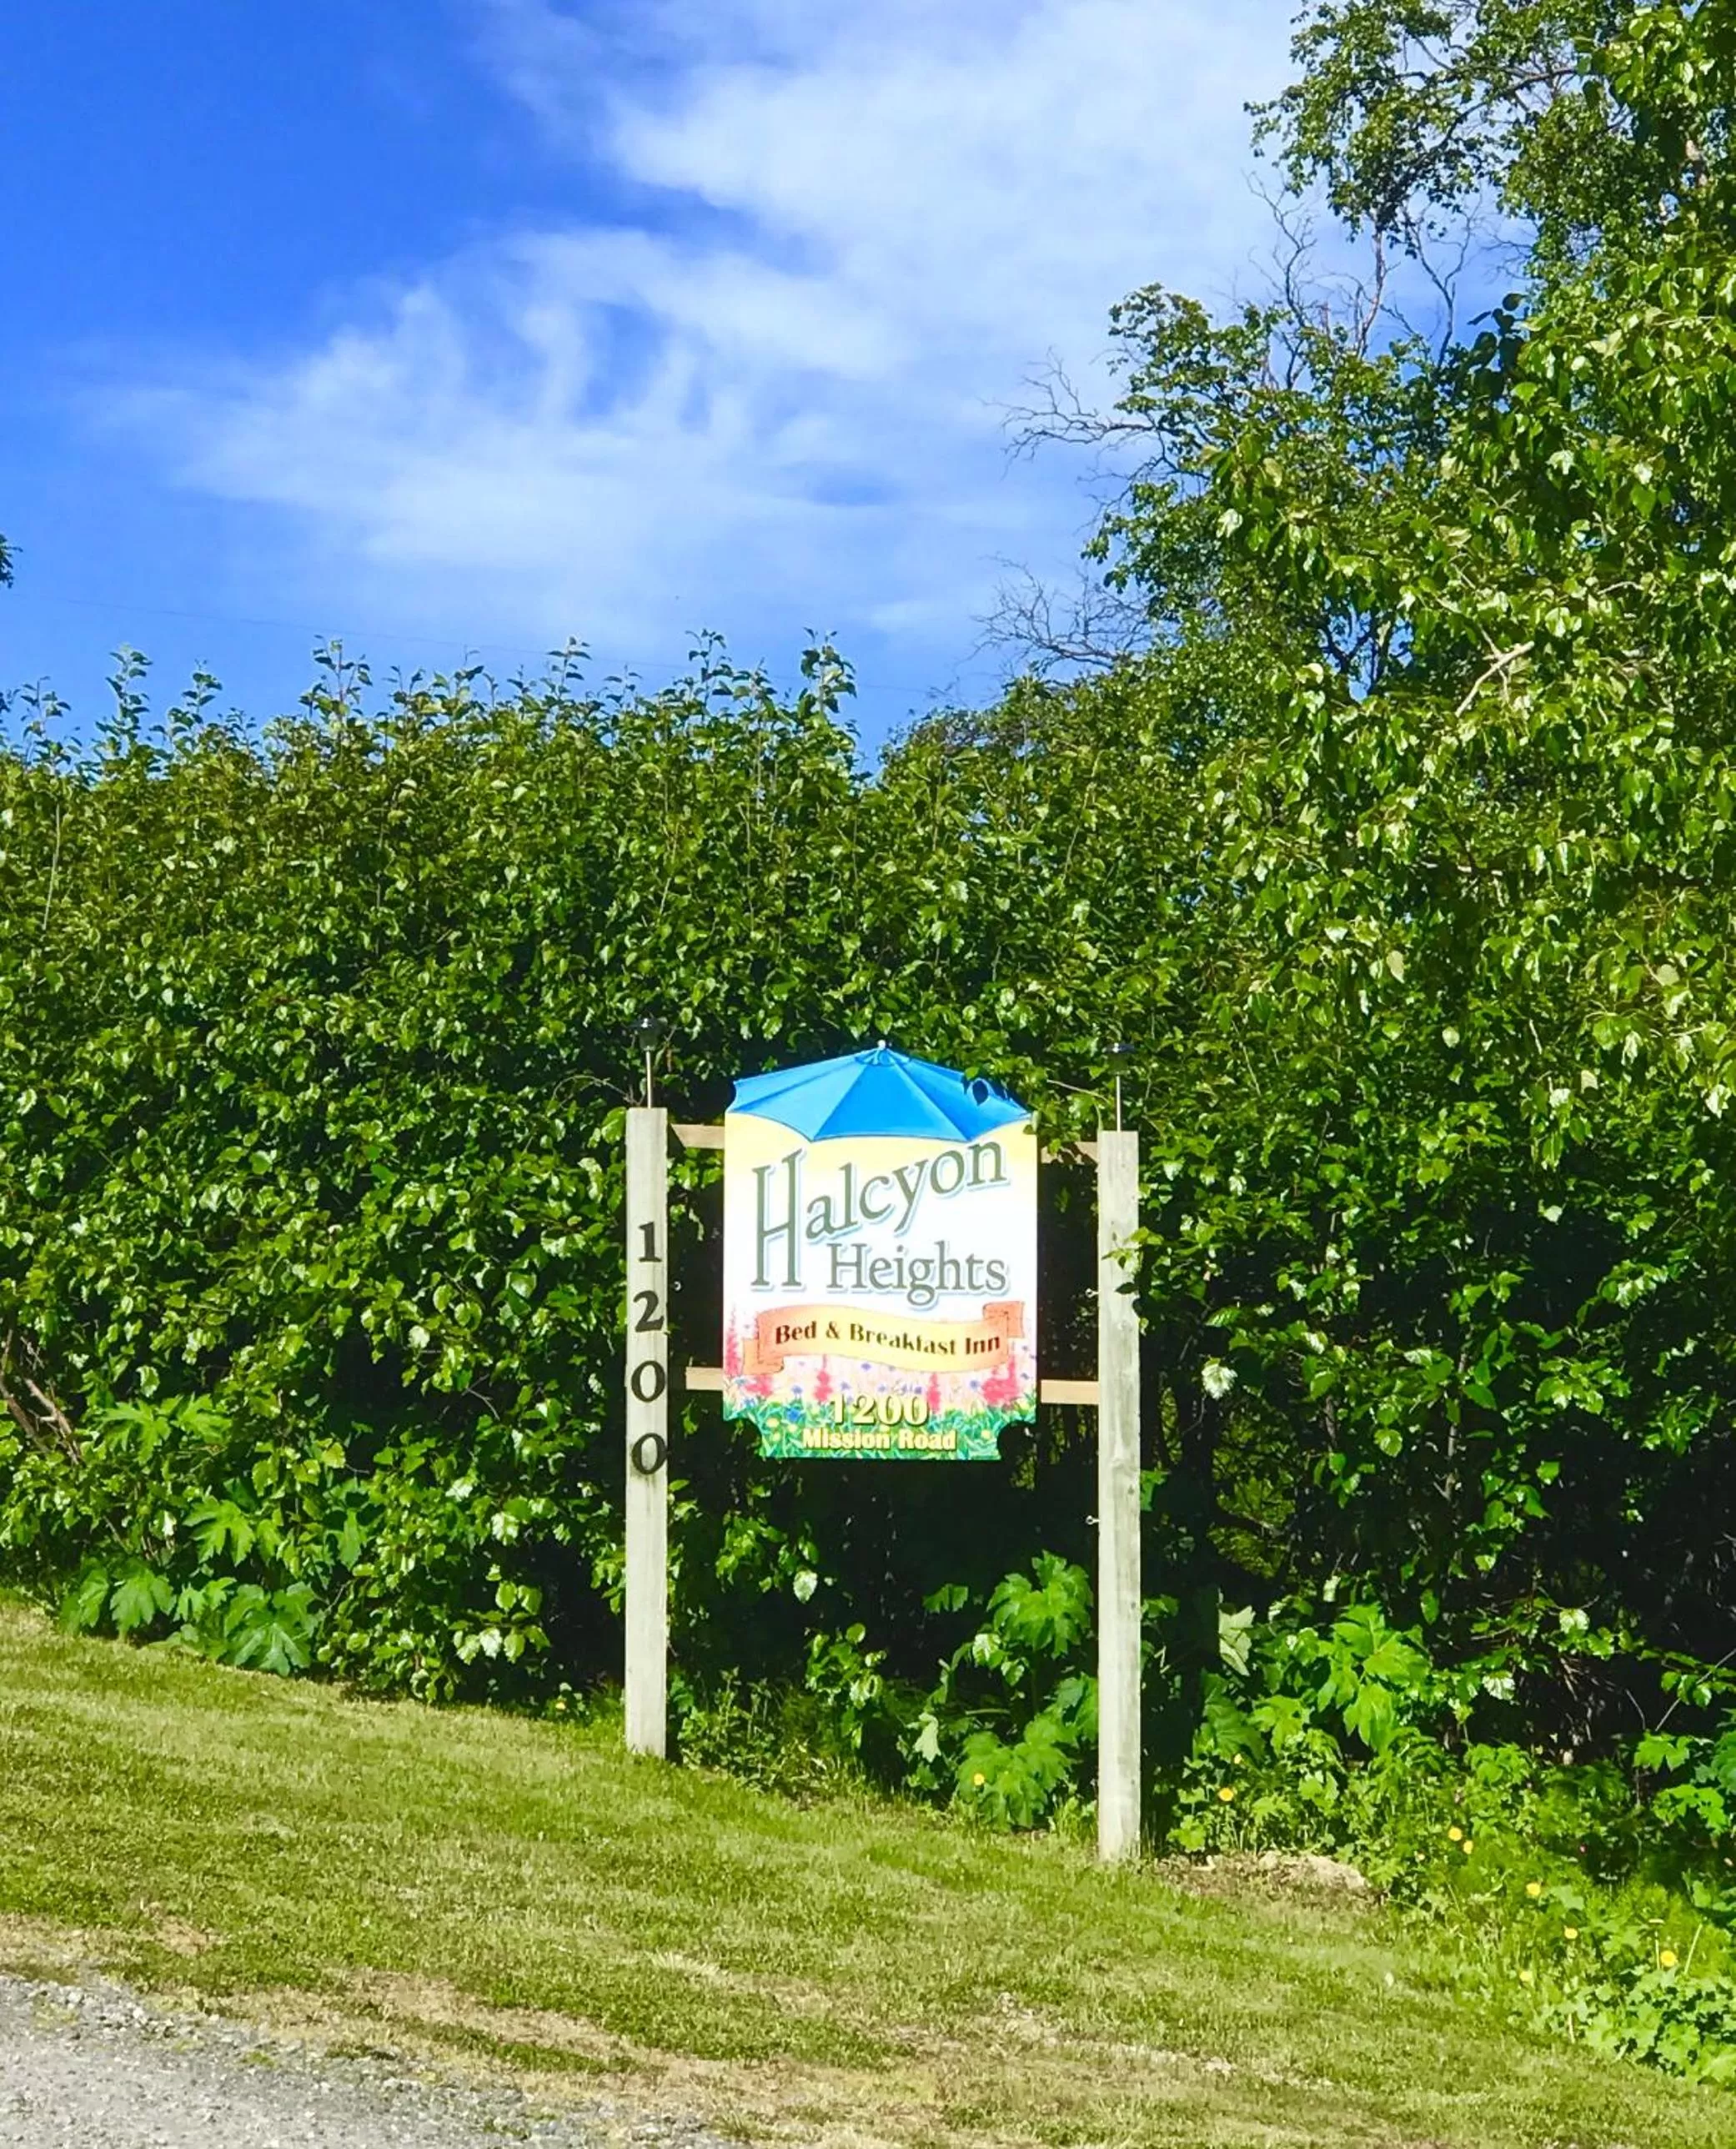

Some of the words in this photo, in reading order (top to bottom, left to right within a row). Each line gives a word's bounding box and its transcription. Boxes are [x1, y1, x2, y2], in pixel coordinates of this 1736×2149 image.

[751, 1141, 1007, 1287] Halcyon
[827, 1241, 1006, 1306] Heights
[631, 1221, 667, 1475] 1200
[775, 1321, 817, 1344] Bed
[825, 1322, 840, 1339] &
[850, 1323, 956, 1354] Breakfast
[965, 1336, 1001, 1354] Inn
[829, 1394, 929, 1426] 1200
[802, 1428, 891, 1450] Mission
[898, 1428, 958, 1451] Road
